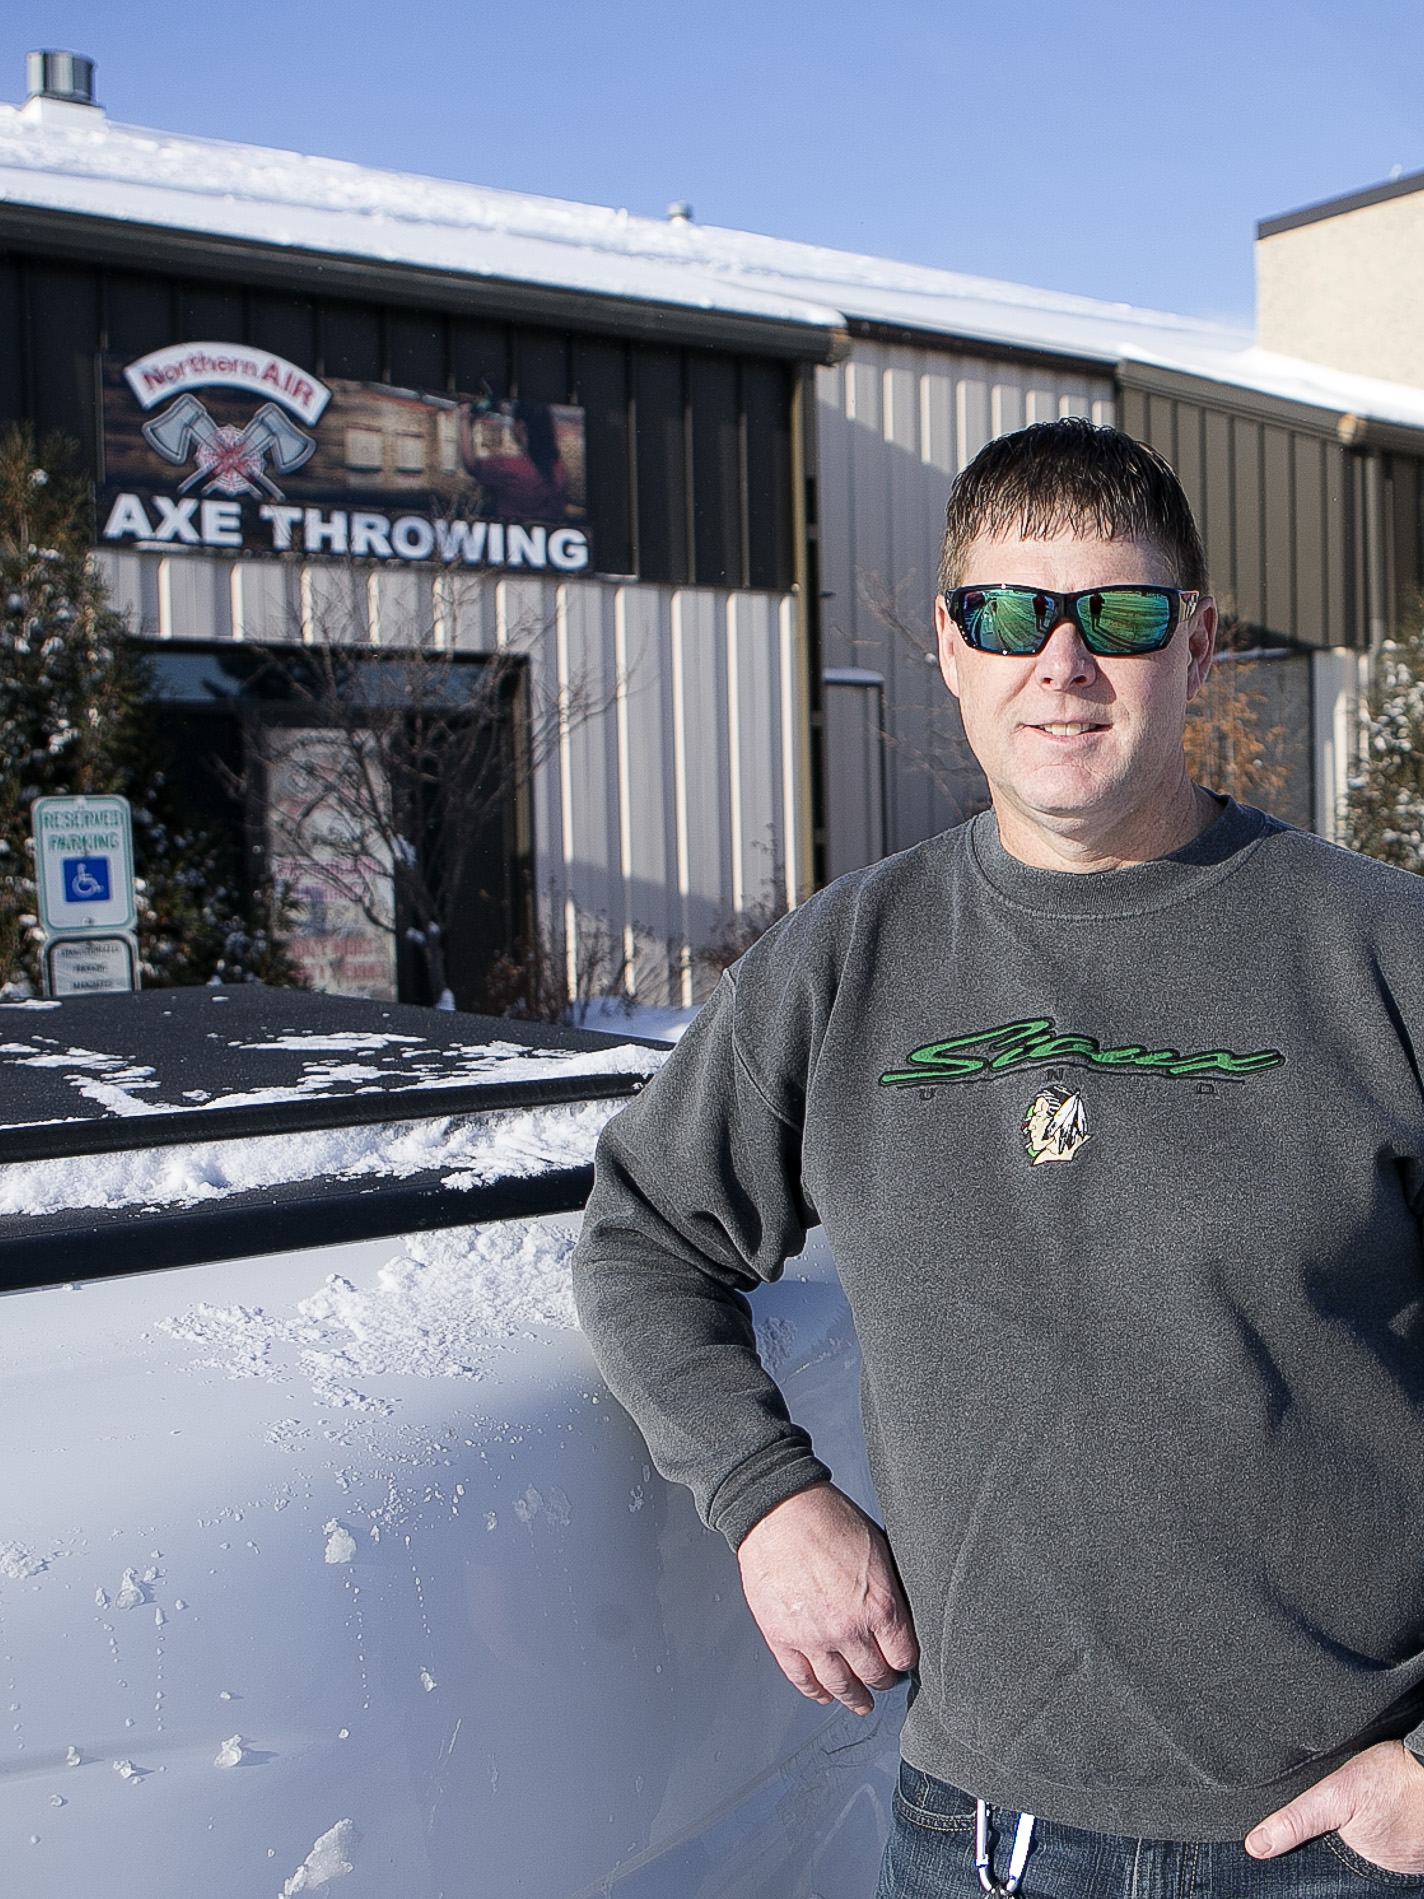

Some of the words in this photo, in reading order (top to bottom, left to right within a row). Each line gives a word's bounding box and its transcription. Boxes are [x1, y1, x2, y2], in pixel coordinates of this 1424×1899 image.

[143, 351, 258, 390] Northern
[261, 359, 315, 407] AIR
[102, 492, 243, 548] AXE
[259, 504, 590, 570] THROWING
[42, 810, 123, 829] RESERVED
[49, 832, 120, 850] PARKING
